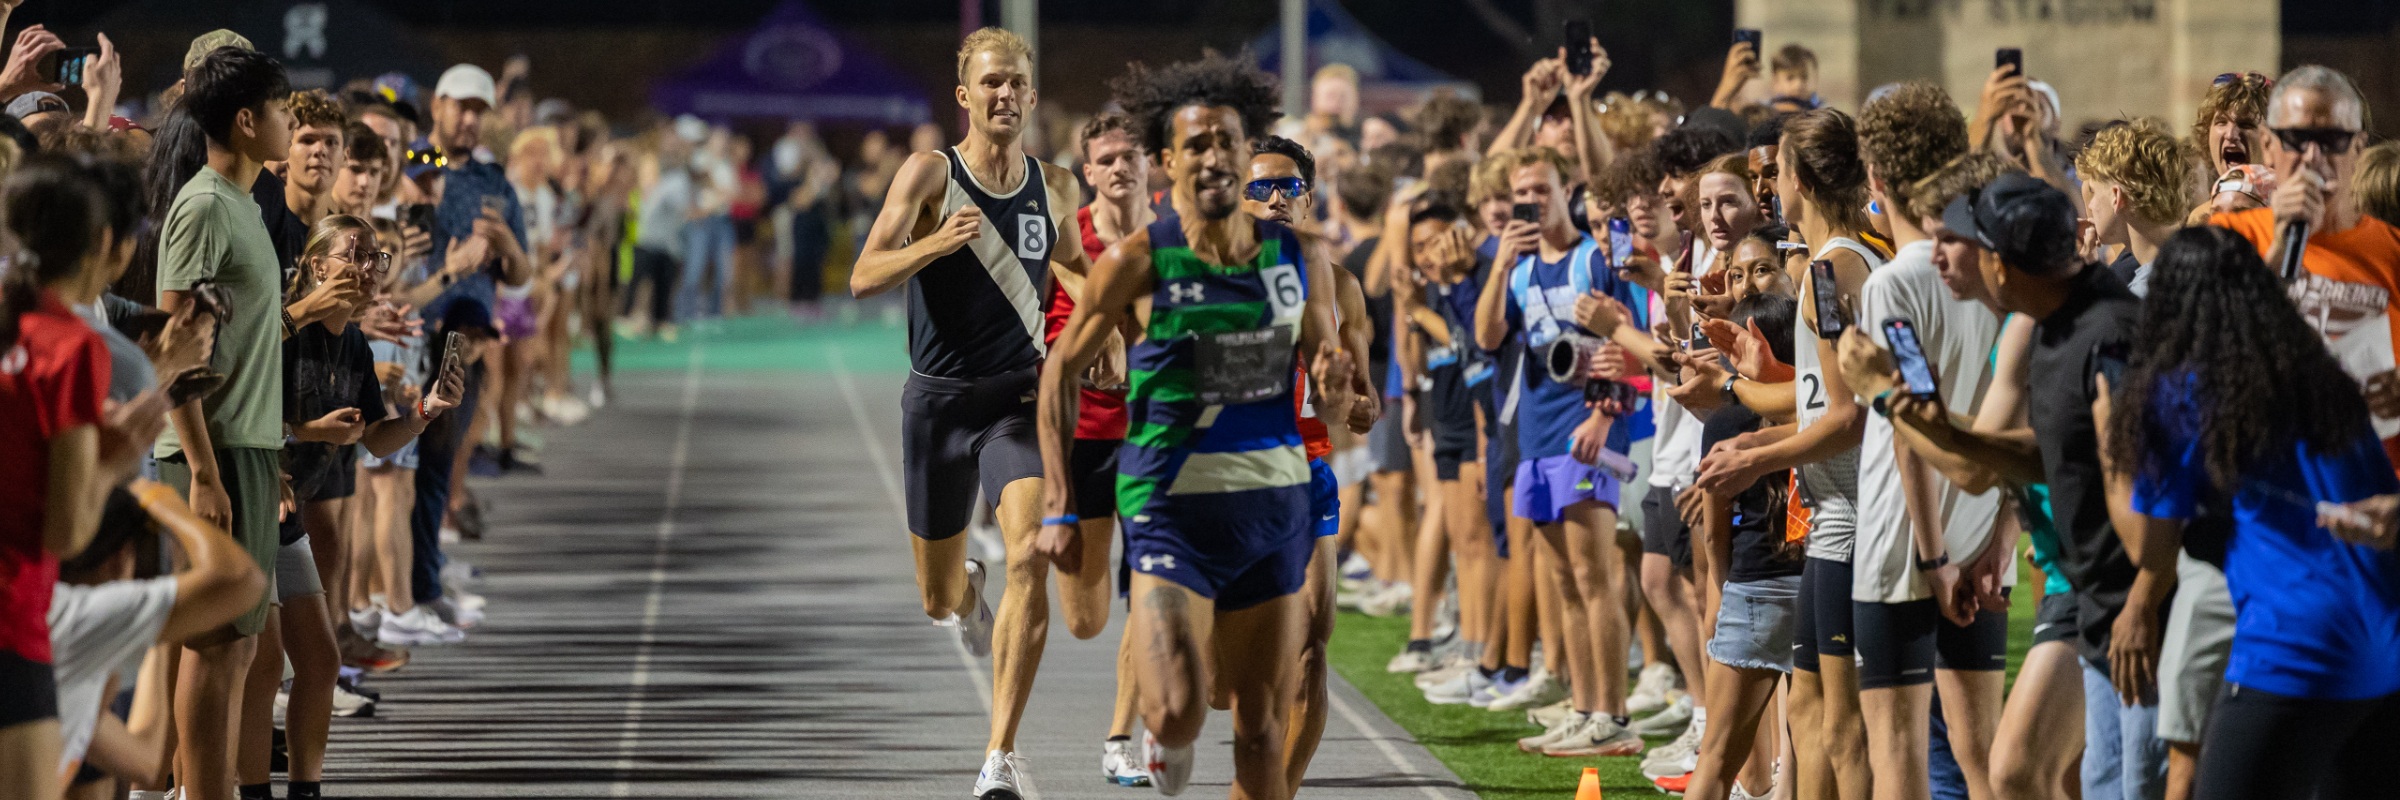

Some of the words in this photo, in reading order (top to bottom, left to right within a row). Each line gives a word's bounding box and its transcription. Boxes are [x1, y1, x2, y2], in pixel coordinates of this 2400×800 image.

[1024, 219, 1044, 252] 8
[1274, 272, 1299, 308] 6
[1802, 373, 1825, 410] 2
